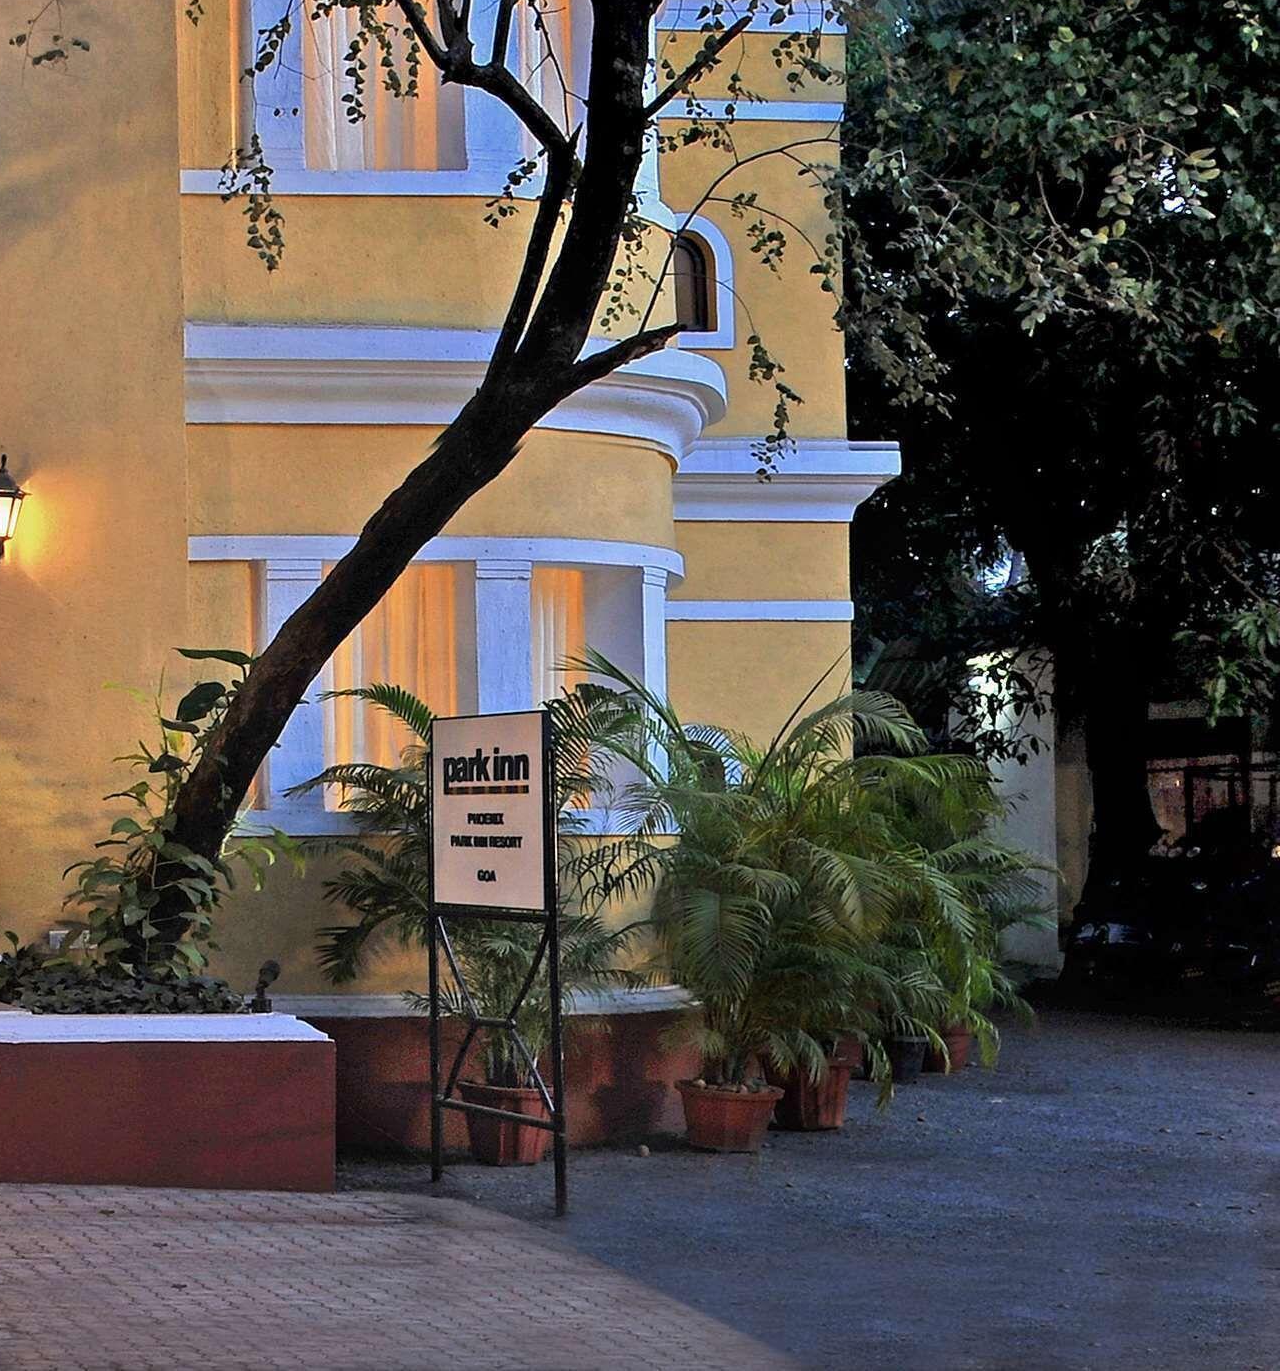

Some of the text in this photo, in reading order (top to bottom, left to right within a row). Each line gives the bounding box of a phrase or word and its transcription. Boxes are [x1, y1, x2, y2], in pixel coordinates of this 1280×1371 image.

[443, 747, 529, 795] park inn
[467, 813, 504, 825] PHOENIX
[450, 835, 473, 847] PARK
[488, 836, 523, 848] RESORT
[477, 869, 496, 882] GOA
